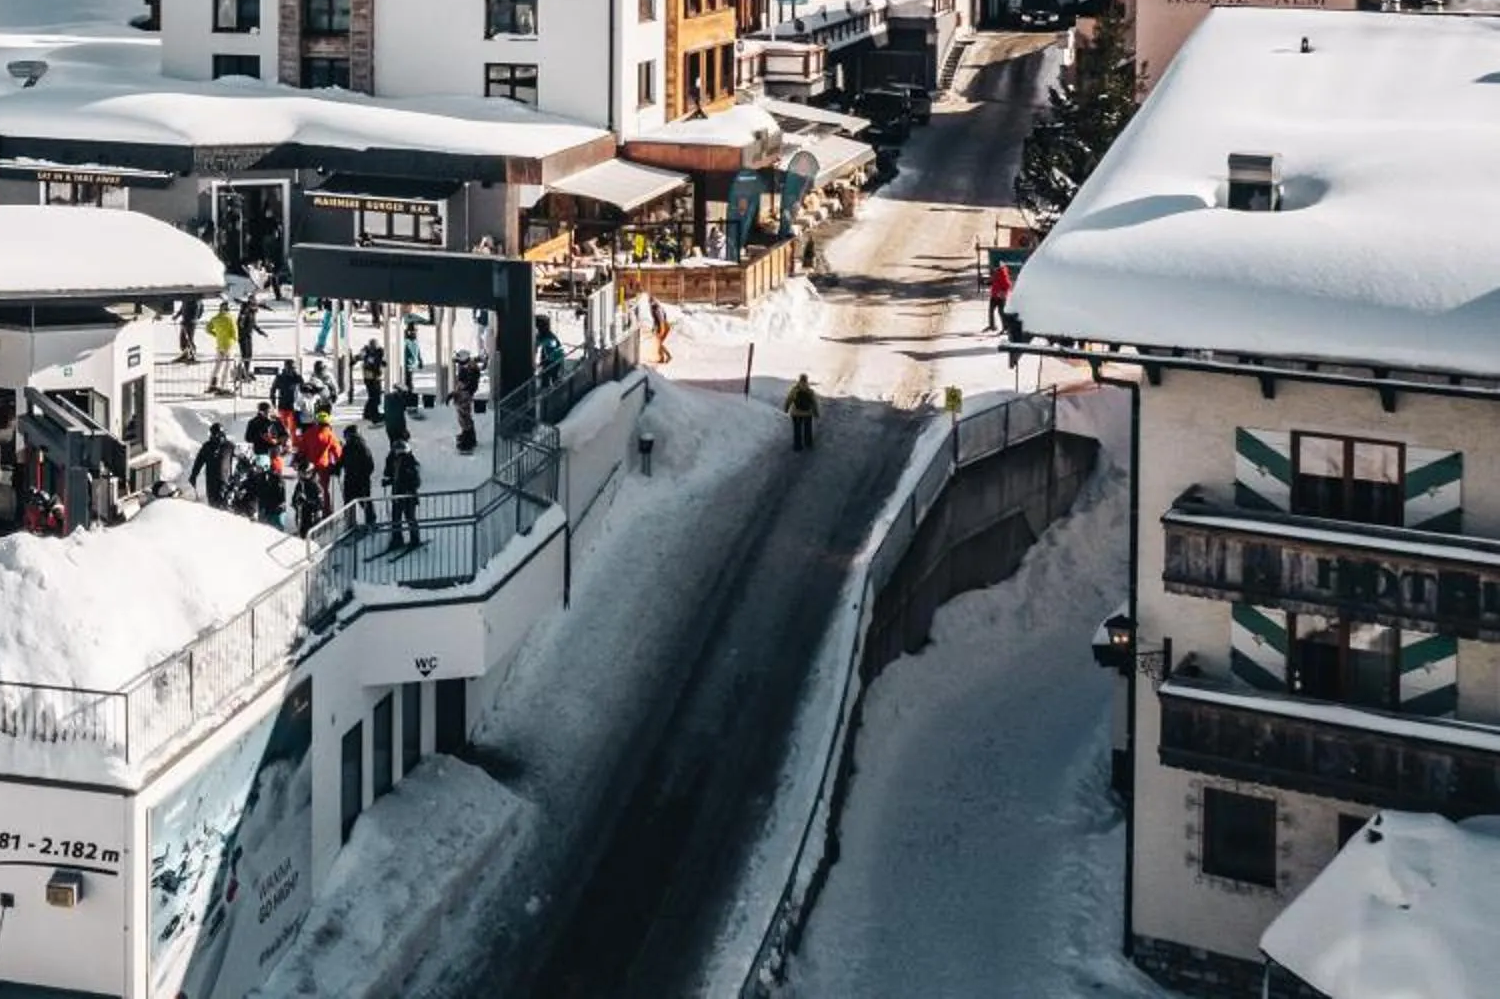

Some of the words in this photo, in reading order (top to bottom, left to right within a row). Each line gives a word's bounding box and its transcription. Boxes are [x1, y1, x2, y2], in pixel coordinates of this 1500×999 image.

[415, 656, 438, 670] WC
[40, 837, 98, 860] 2.182
[101, 849, 120, 862] m
